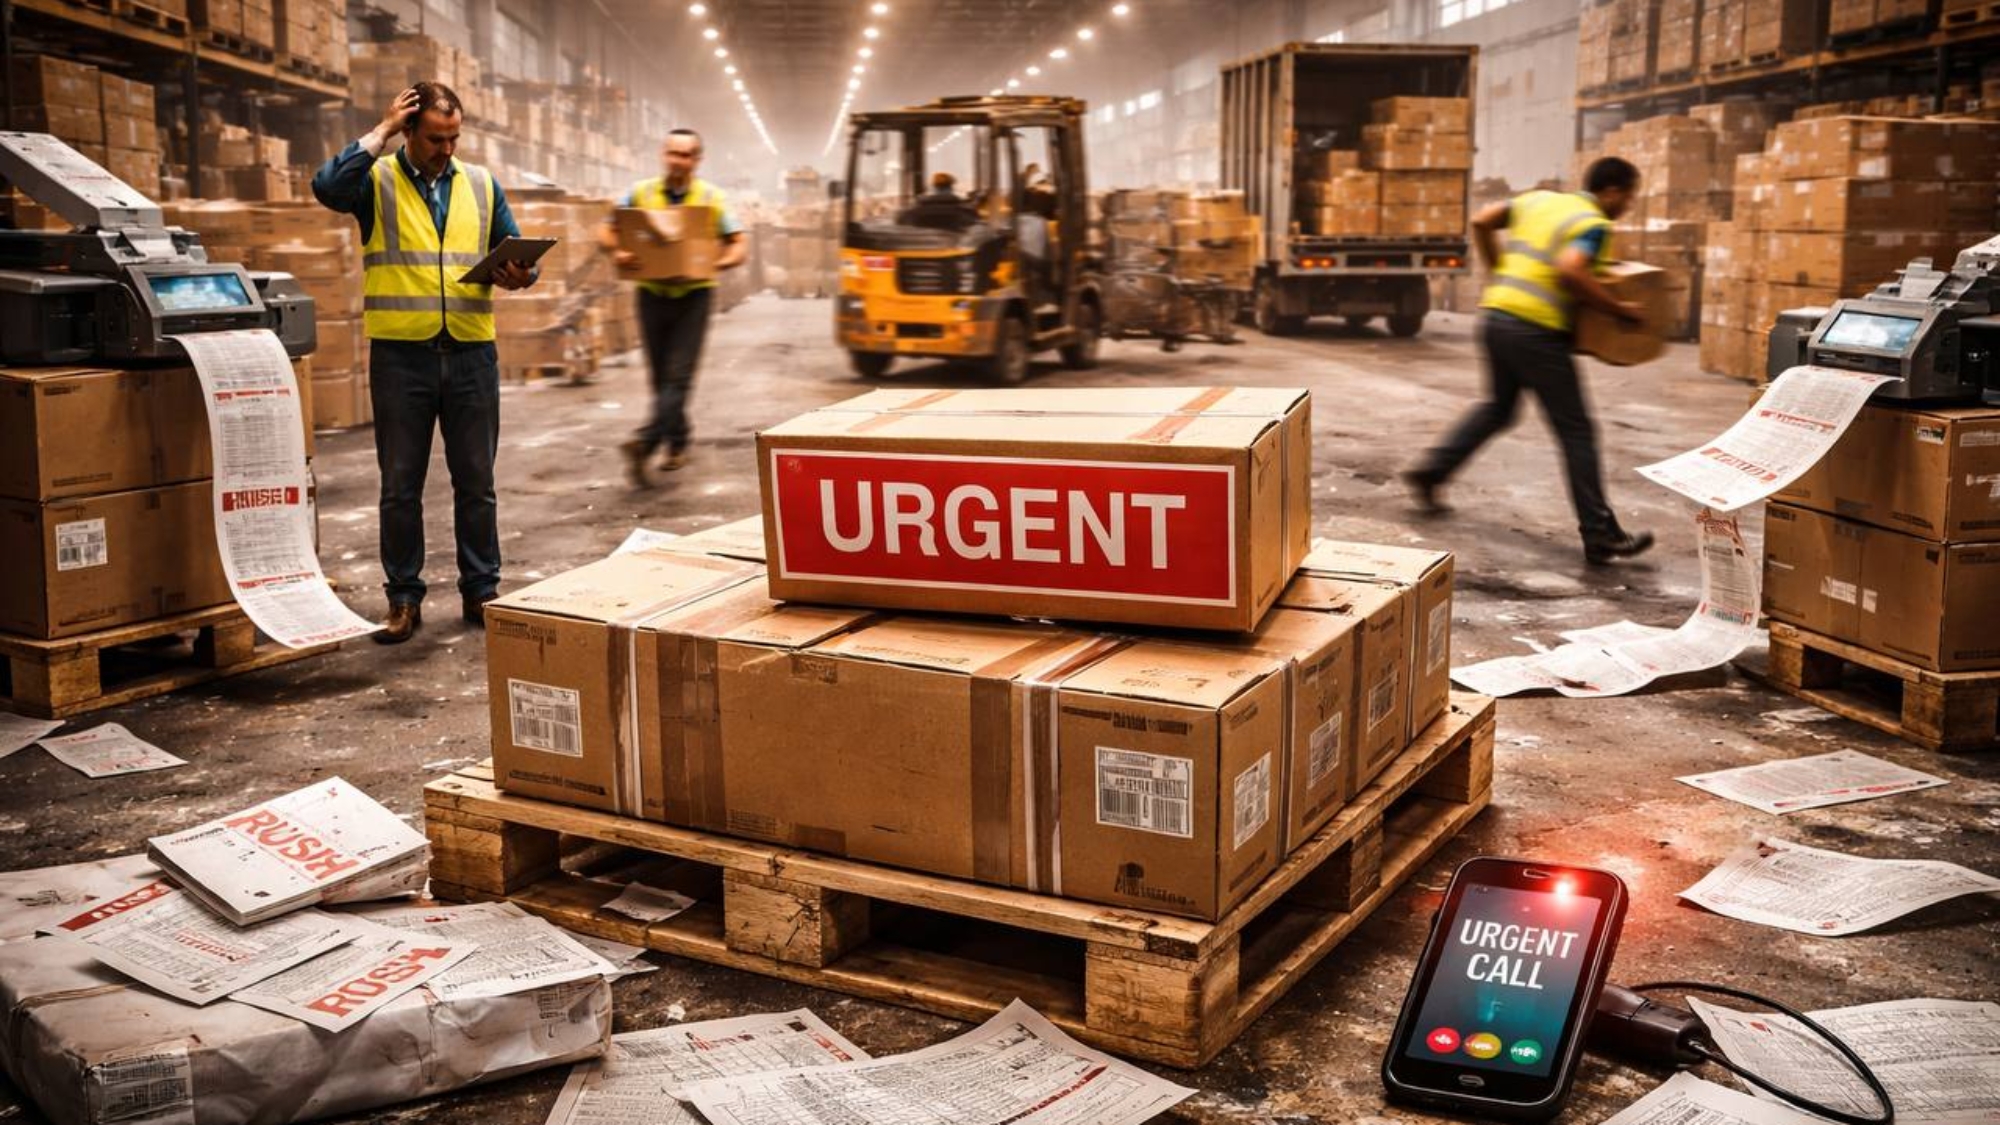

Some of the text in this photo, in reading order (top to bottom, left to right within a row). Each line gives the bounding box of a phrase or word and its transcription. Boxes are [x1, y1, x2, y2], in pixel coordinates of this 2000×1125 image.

[819, 479, 1186, 569] URGENT
[223, 809, 360, 880] RUSH
[1460, 919, 1578, 959] URGENT
[1466, 953, 1544, 989] CALL
